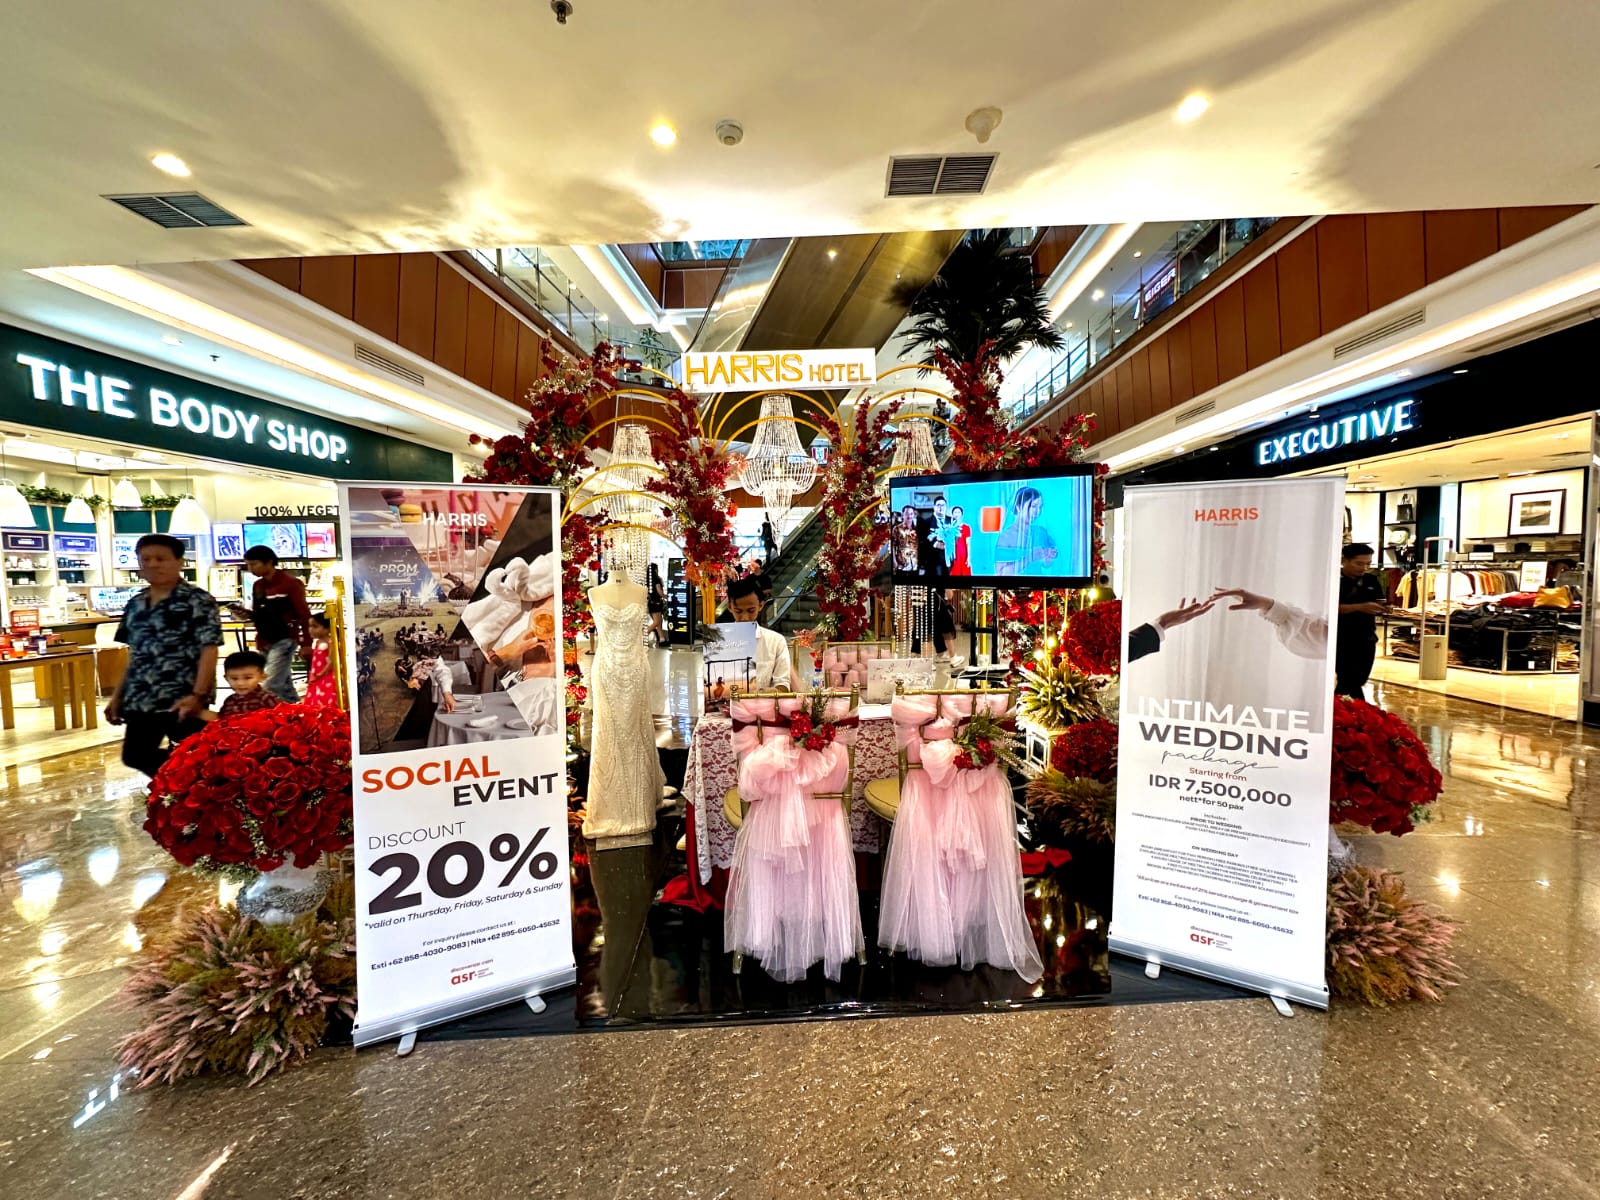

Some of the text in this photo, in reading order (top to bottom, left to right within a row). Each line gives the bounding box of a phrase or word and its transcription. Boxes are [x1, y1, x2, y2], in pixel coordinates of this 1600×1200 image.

[686, 354, 872, 385] HARRIS HOTEL
[16, 354, 136, 418] THE
[150, 388, 260, 444] BODY
[1257, 398, 1416, 467] EXECUTIVE
[254, 505, 293, 517] 100%
[422, 512, 488, 527] HARRIS
[1194, 507, 1259, 522] HARRIS
[379, 563, 418, 573] PROM
[1138, 696, 1310, 733] INTIMATE
[1139, 721, 1309, 760] WEDDING
[362, 755, 500, 794] SOCIAL
[1161, 748, 1279, 774] package
[1189, 767, 1247, 782] Starting from
[453, 772, 559, 807] EVENT
[1149, 774, 1292, 807] IDR 7,500,000
[1228, 803, 1244, 811] pax
[369, 821, 466, 850] DISCOUNT
[368, 827, 558, 915] 20%
[393, 916, 406, 925] on
[408, 905, 453, 921] Thursday,
[454, 899, 484, 911] Friday,
[485, 890, 525, 904] Saturday
[533, 881, 563, 894] Sunday
[434, 935, 456, 944] inquiry
[456, 930, 476, 940] please
[476, 924, 499, 933] contact
[371, 961, 387, 971] Esti
[388, 957, 403, 967] +62
[404, 941, 467, 963] 858-4030-9083
[470, 937, 487, 946] Nita
[487, 933, 501, 941] +62
